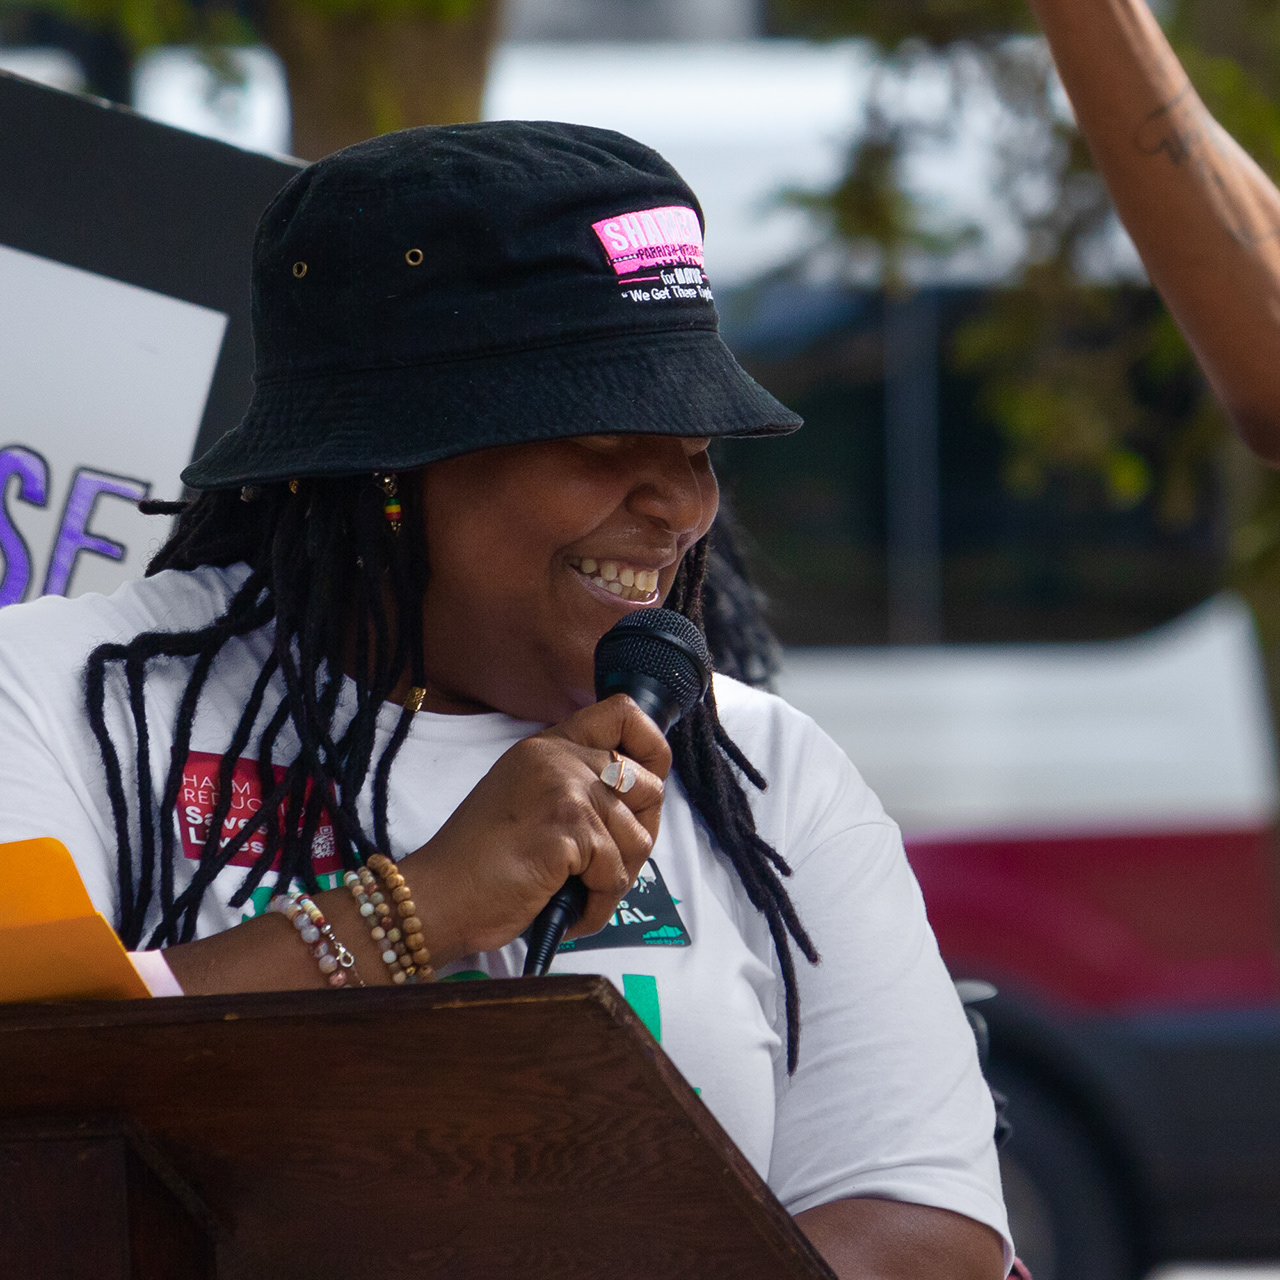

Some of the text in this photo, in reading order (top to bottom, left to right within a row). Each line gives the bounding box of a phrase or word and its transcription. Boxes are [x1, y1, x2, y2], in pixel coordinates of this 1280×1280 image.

[660, 269, 676, 286] for
[651, 286, 671, 301] Get
[182, 773, 251, 796] HAM
[188, 826, 266, 854] Lves
